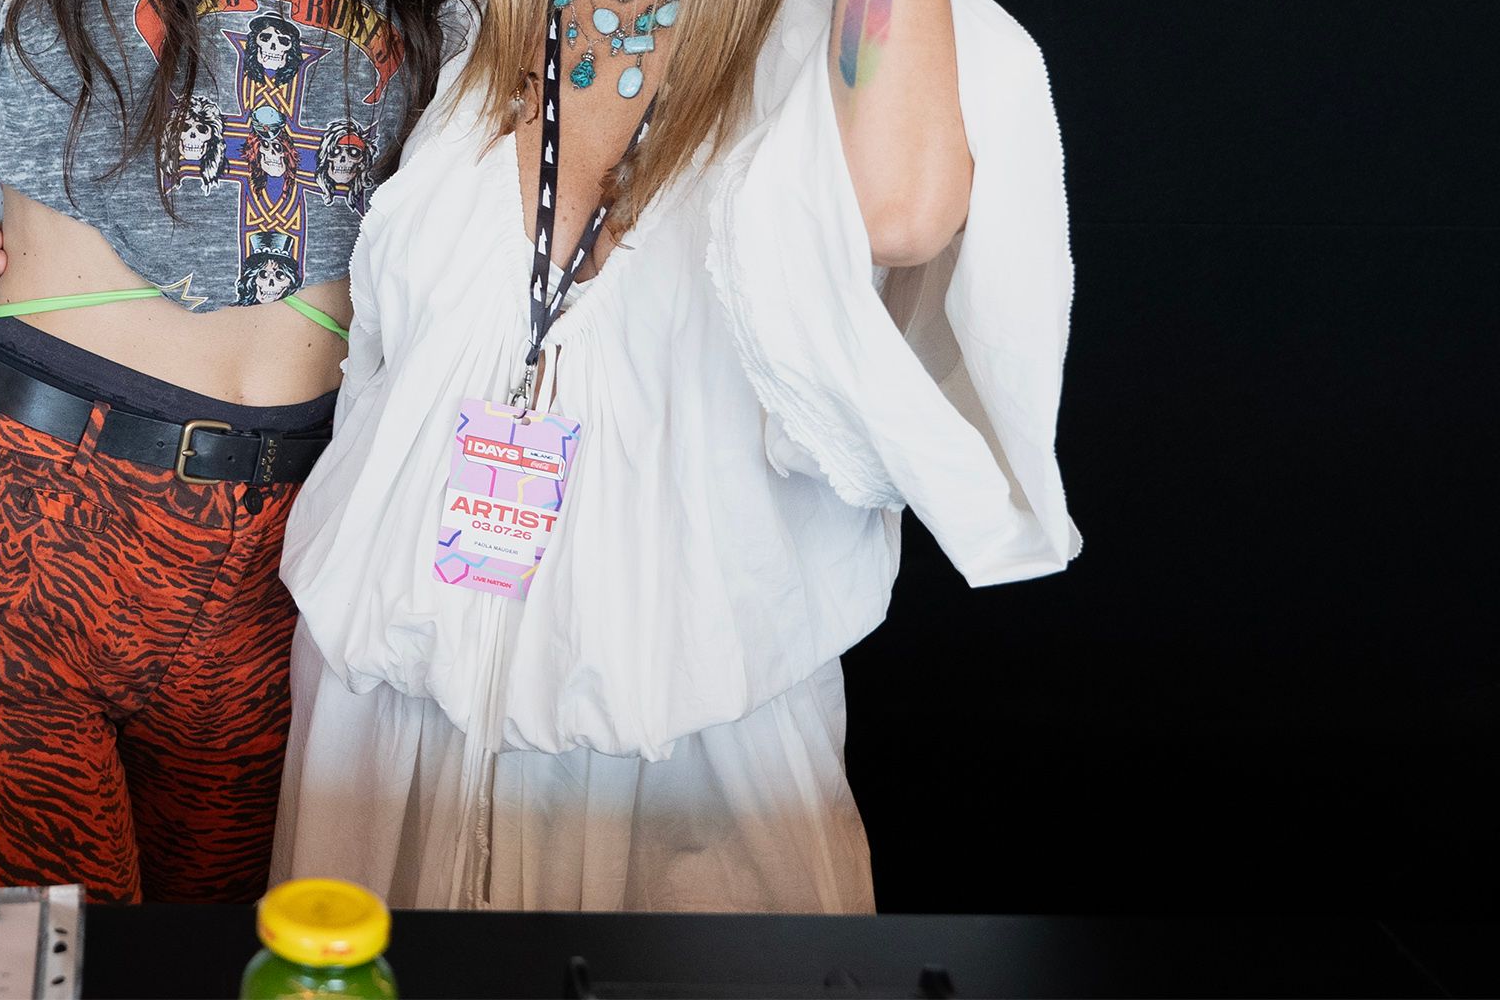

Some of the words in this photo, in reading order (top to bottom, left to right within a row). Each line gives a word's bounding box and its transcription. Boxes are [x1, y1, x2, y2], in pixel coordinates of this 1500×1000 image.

[450, 495, 558, 533] ARTIST
[471, 520, 533, 541] 03.07.26
[472, 575, 486, 583] LIVE
[487, 578, 512, 589] NATION
